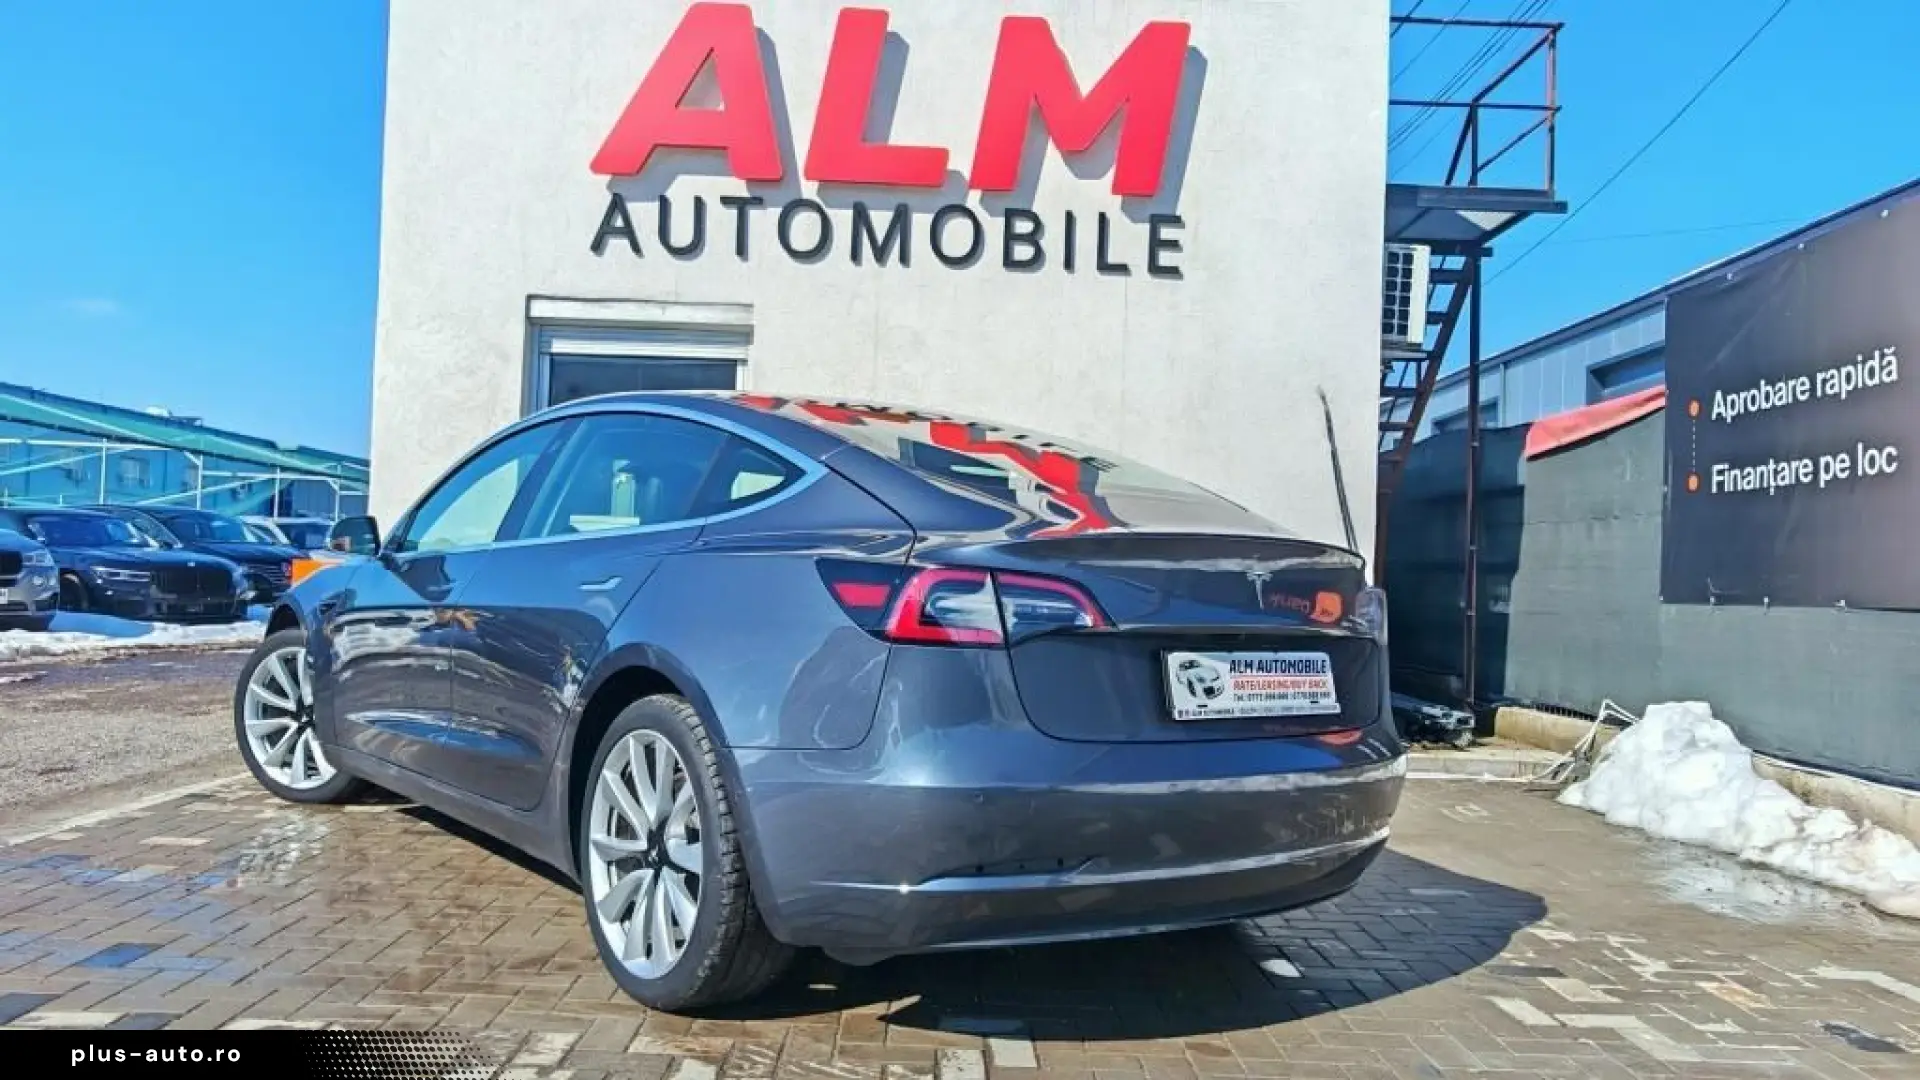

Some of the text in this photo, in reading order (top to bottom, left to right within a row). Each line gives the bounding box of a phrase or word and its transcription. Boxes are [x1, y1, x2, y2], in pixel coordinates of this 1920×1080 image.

[590, 2, 1191, 197] ALM
[590, 192, 1186, 277] AUTOMOBILE
[1711, 346, 1899, 422] Aprobare rapidă
[1711, 442, 1898, 495] Finanțare pe loc
[1229, 660, 1327, 674] ALM AUTOMOBILE
